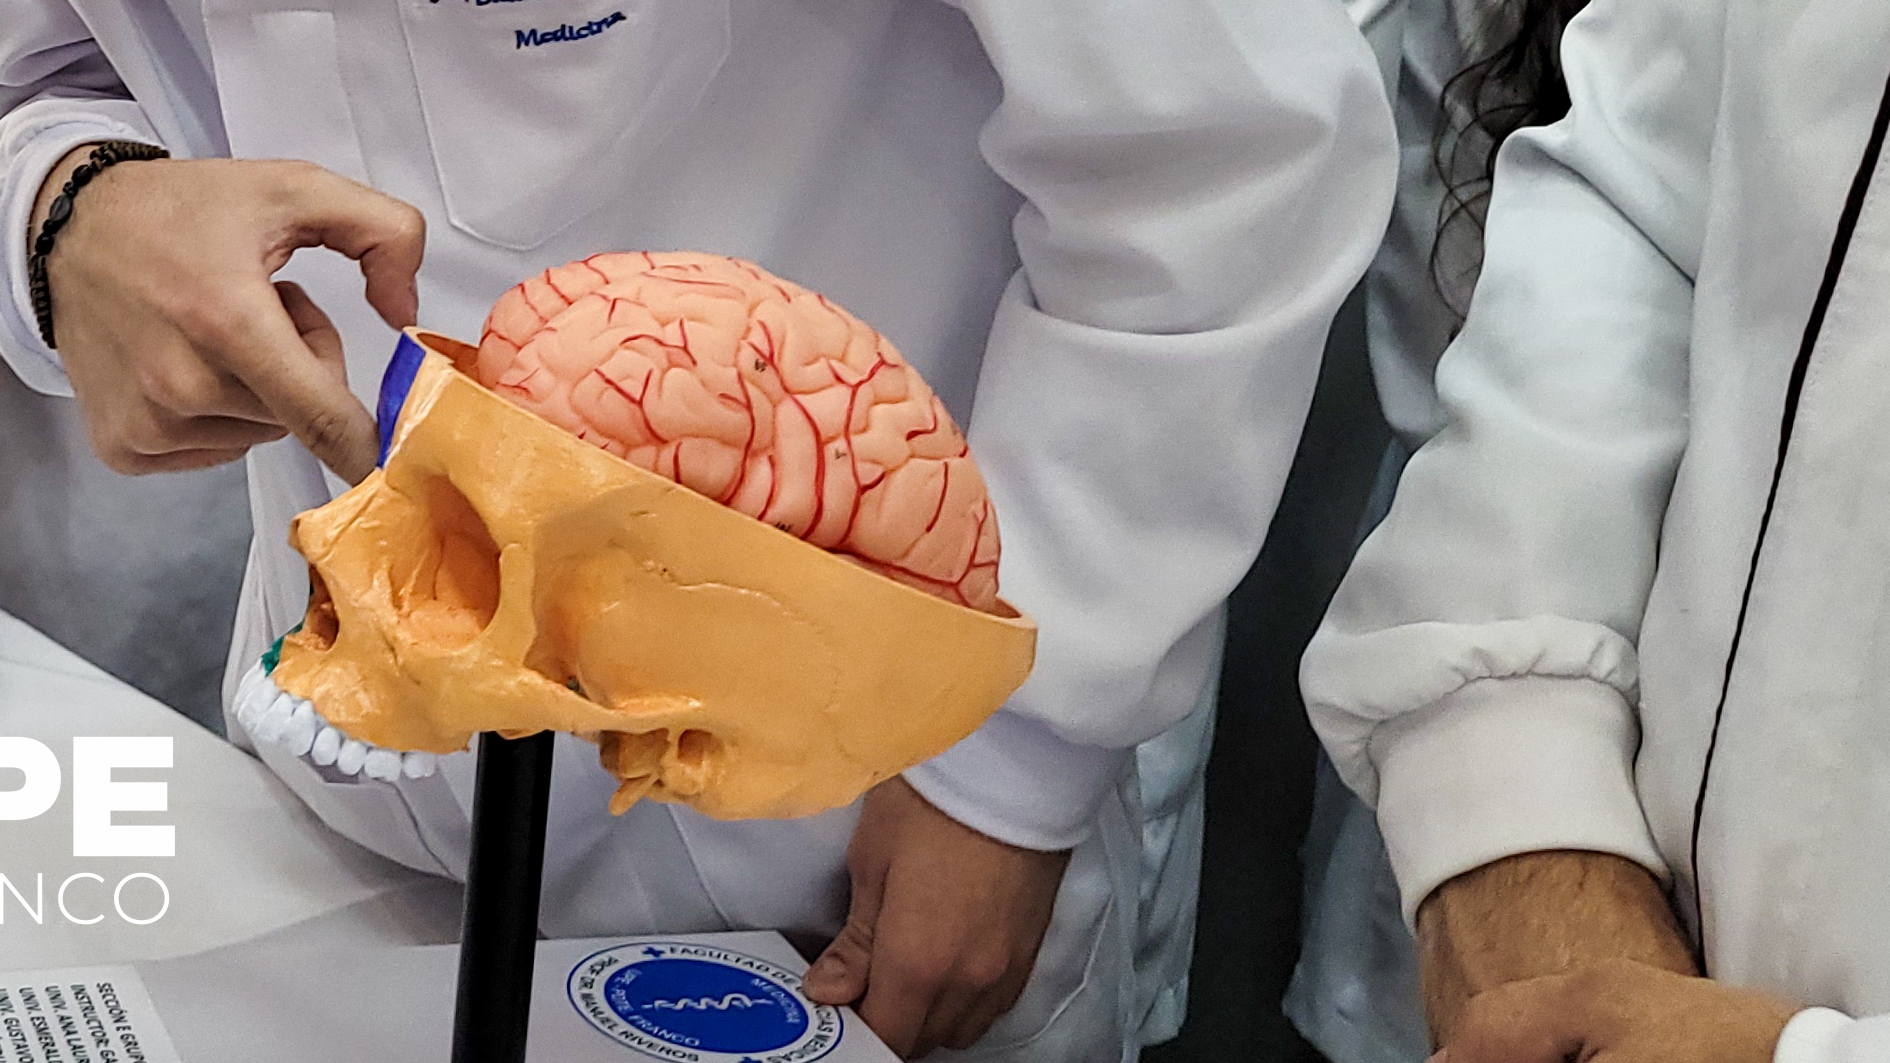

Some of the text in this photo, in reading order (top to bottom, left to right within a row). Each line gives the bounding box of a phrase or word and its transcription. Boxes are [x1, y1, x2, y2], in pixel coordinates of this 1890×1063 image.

[515, 10, 627, 50] Medicina
[18, 987, 44, 1015] UNIV.
[45, 985, 67, 1013] UNIV.
[58, 1014, 79, 1038] ANA
[96, 982, 132, 1024] SECCIÓN
[618, 1029, 700, 1062] RIVEROS
[628, 1015, 700, 1046] FRANCO
